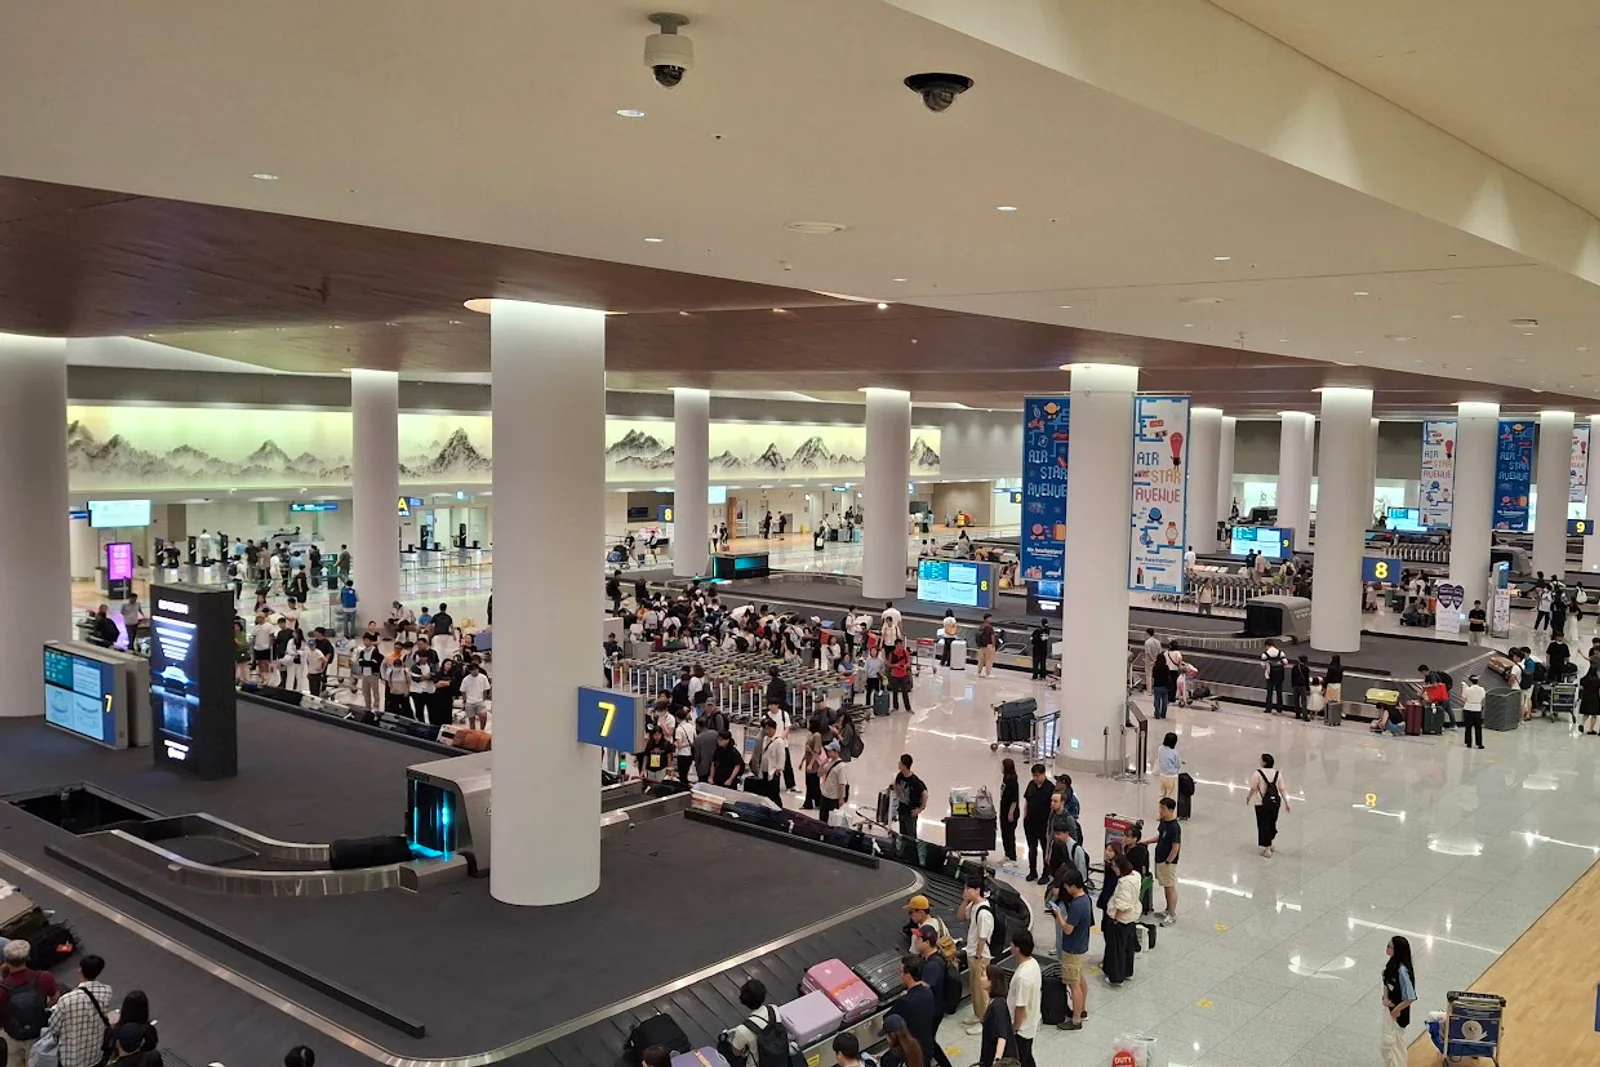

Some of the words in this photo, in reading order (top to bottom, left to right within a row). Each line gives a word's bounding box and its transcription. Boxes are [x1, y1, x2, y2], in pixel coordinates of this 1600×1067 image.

[1028, 449, 1048, 463] AIR
[1137, 451, 1159, 466] AIR
[1424, 450, 1439, 459] AIR
[1500, 452, 1515, 461] AIR
[1433, 460, 1452, 468] STAR
[1508, 462, 1529, 470] STAR
[1040, 466, 1067, 480] STAR
[1150, 469, 1181, 485] STAR
[1423, 470, 1452, 479] AVENUE
[1498, 472, 1529, 480] AVENUE
[1028, 483, 1067, 498] AVENUE
[1135, 487, 1180, 503] AVENUE
[397, 497, 408, 511] A
[664, 509, 672, 521] 8
[1576, 521, 1586, 533] 9
[1375, 561, 1388, 578] 8
[981, 581, 988, 591] 8
[105, 694, 113, 713] 7
[598, 701, 617, 738] 7
[1365, 793, 1377, 807] 8
